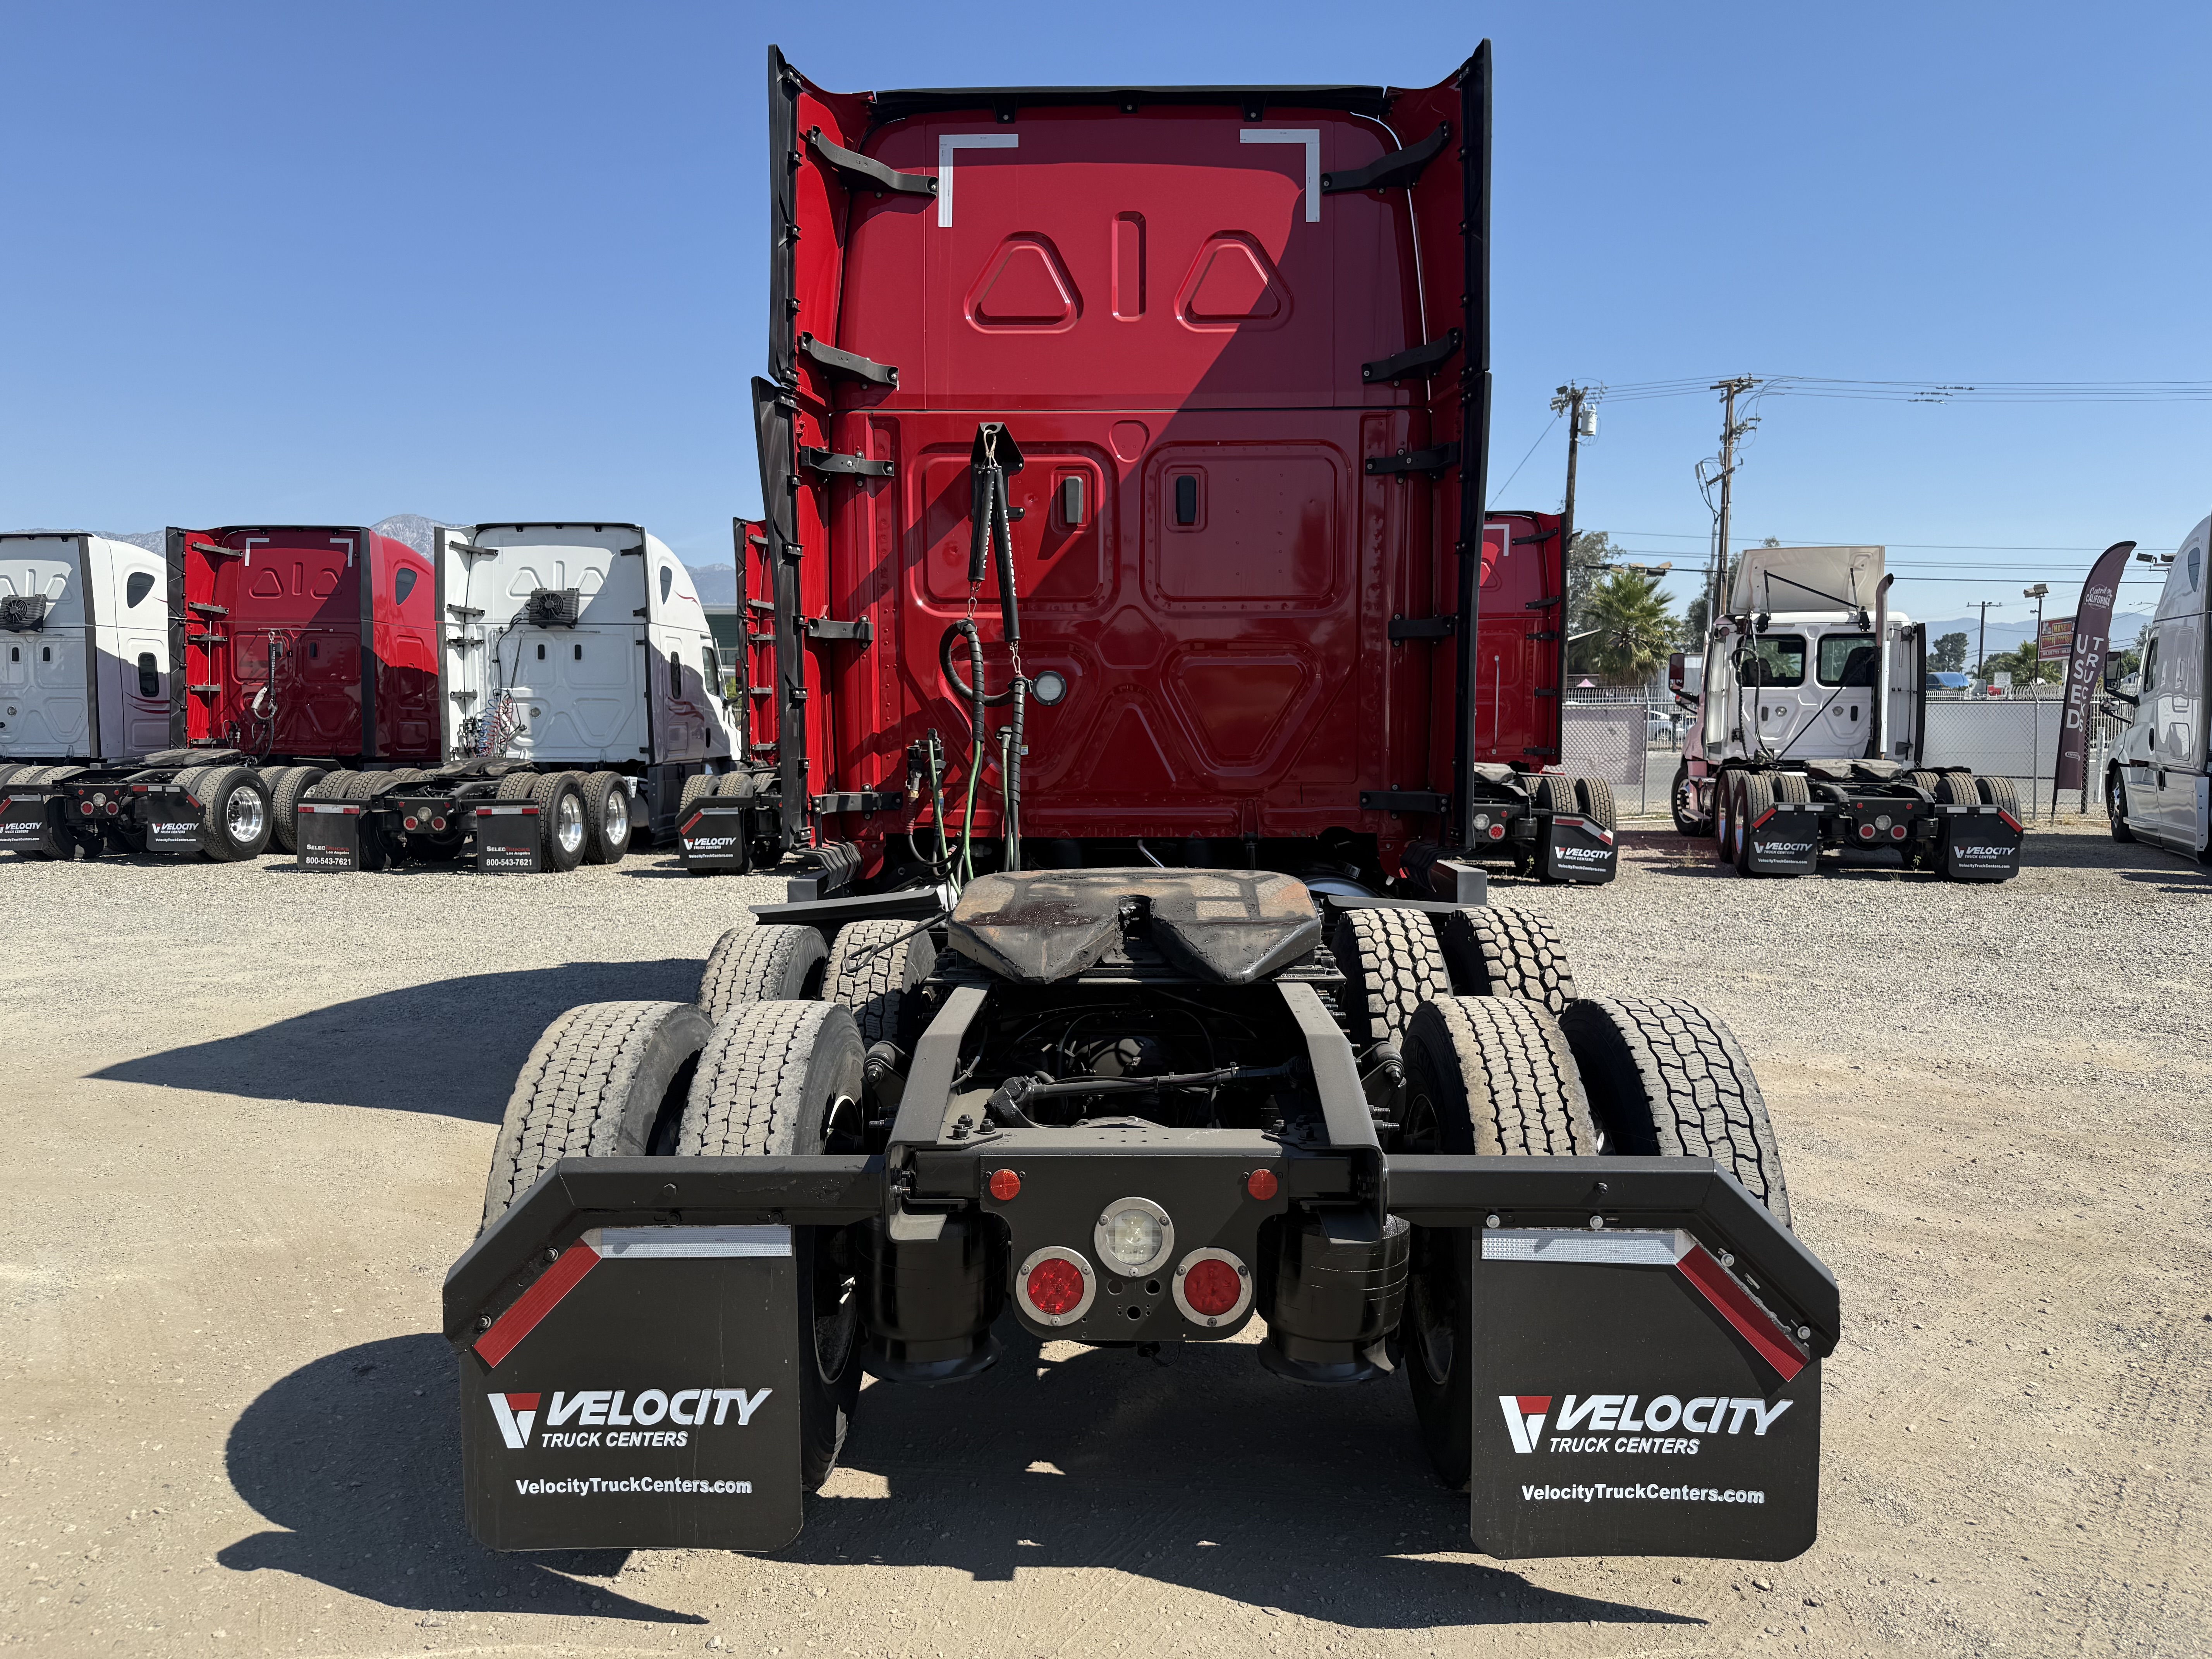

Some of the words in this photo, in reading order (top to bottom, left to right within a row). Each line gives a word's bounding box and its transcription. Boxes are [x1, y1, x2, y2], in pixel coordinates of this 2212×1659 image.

[2086, 594, 2110, 606] CALIFORNIA
[2066, 634, 2089, 729] USED
[2079, 636, 2104, 732] TRUCKS
[694, 837, 737, 845] VELOCITY
[1765, 842, 1813, 851] VELOCITY
[1566, 847, 1613, 859] VELOCITY
[1966, 847, 2016, 855] VELOCITY
[306, 857, 351, 865] 800-543-7621
[547, 1388, 773, 1426] VELOCITY
[1556, 1395, 1794, 1435] VELOCITY
[542, 1432, 601, 1448] TRUCK
[606, 1431, 689, 1448] CENTERS
[1549, 1437, 1609, 1453] TRUCK
[1614, 1437, 1700, 1455] CENTERS
[516, 1477, 753, 1496] VelocityTruckCenters.com
[1522, 1483, 1765, 1504] VelocityTruckCenters.com
